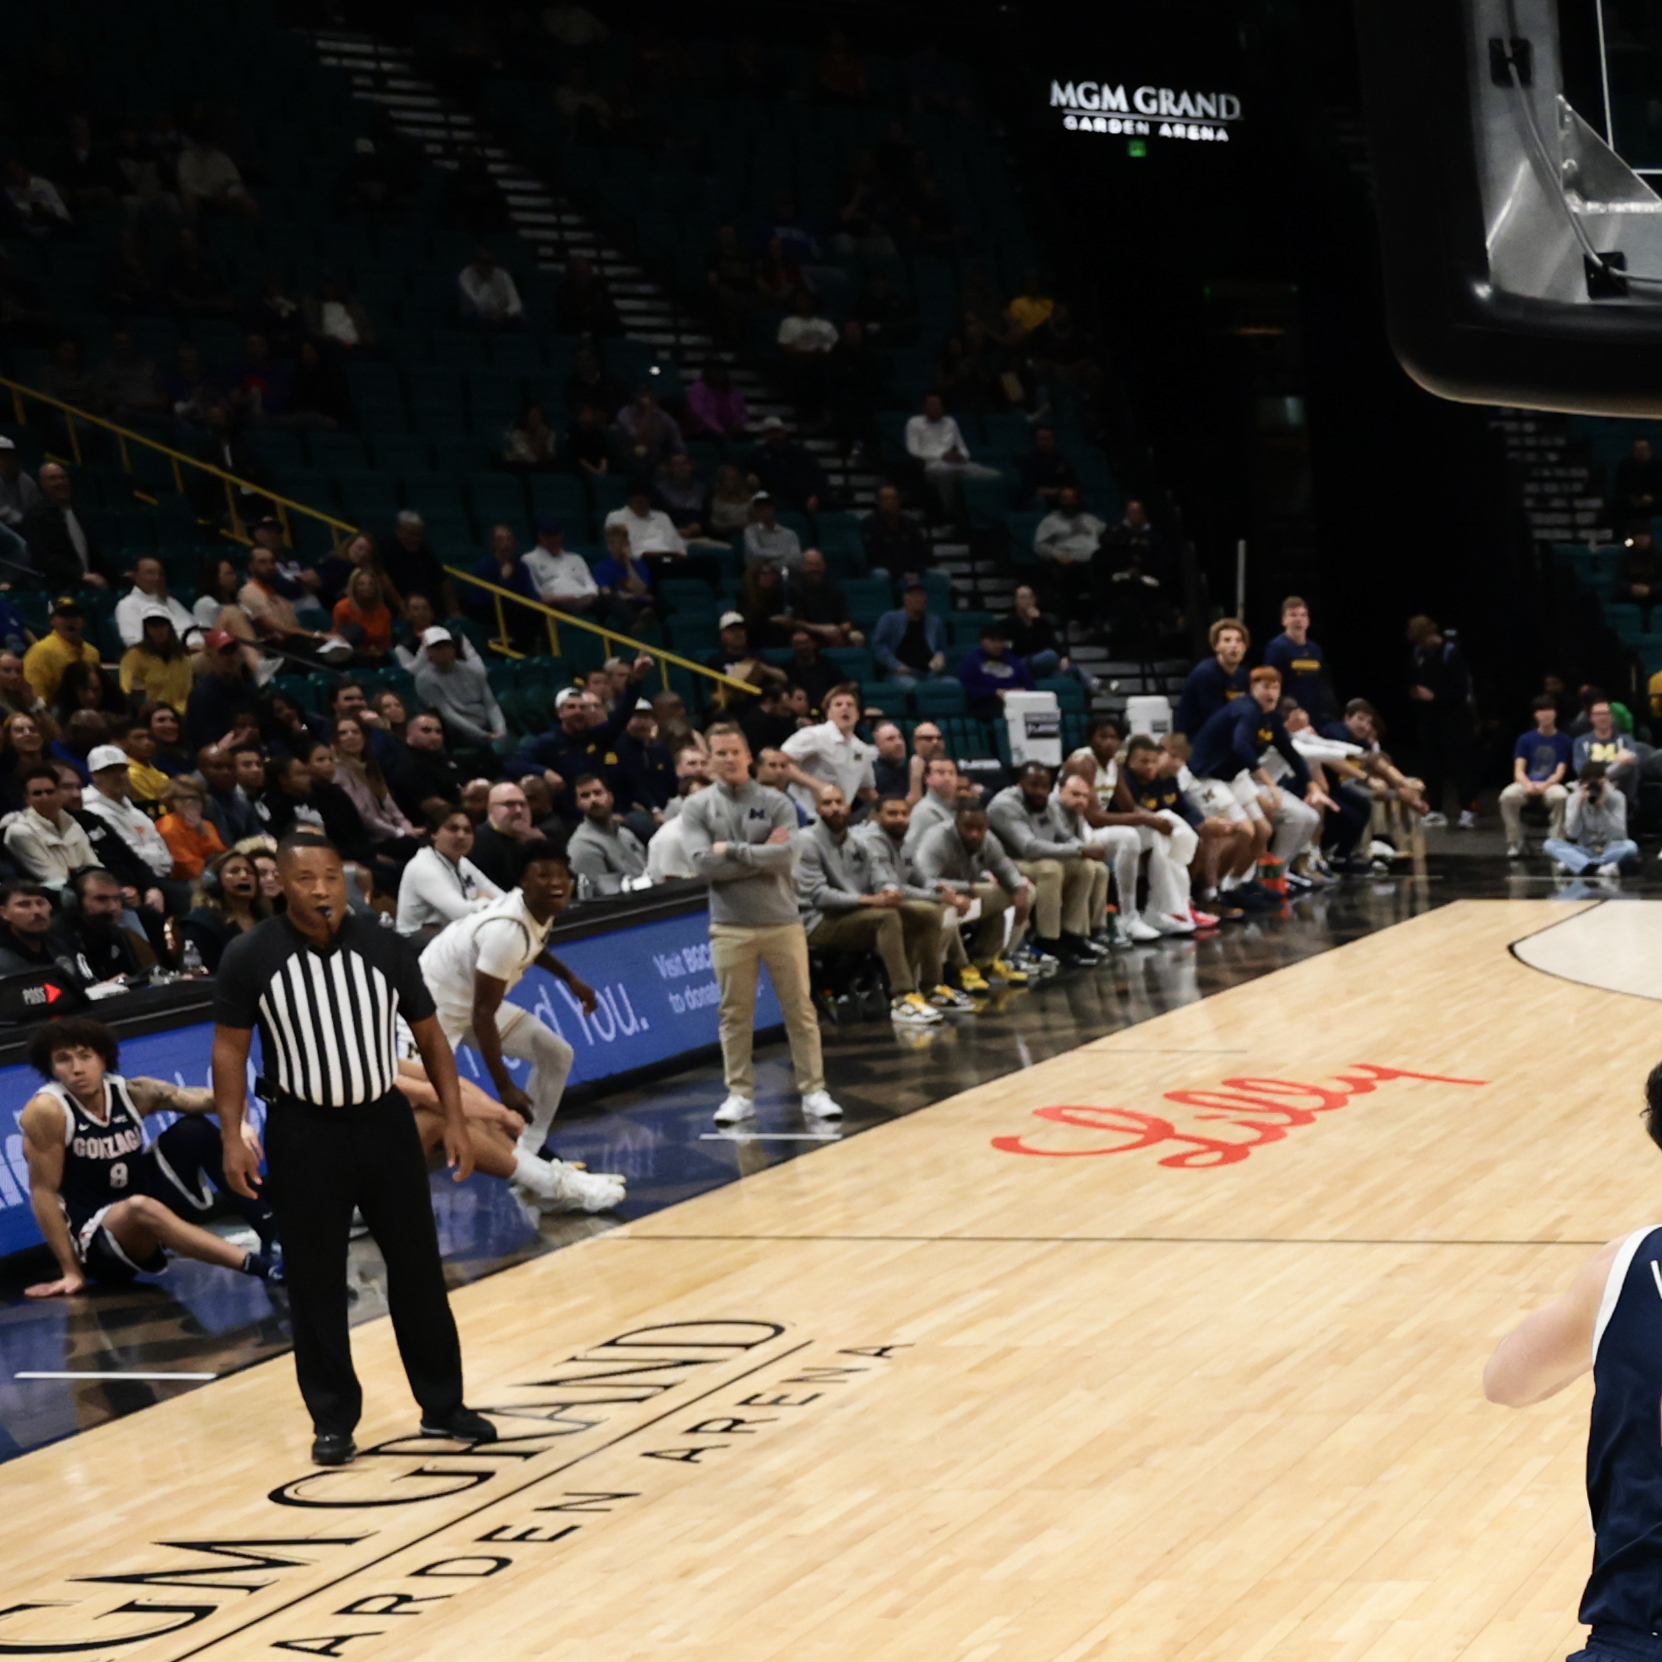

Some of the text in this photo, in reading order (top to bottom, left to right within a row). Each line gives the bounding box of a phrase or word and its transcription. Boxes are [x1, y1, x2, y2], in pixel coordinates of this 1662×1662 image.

[1050, 79, 1241, 121] MGM GRAND
[1063, 114, 1230, 143] GARDEN ARENA
[652, 952, 687, 979] Visit
[668, 991, 686, 1014] to
[267, 1318, 795, 1509] GRAND
[641, 1342, 916, 1464] ARENA
